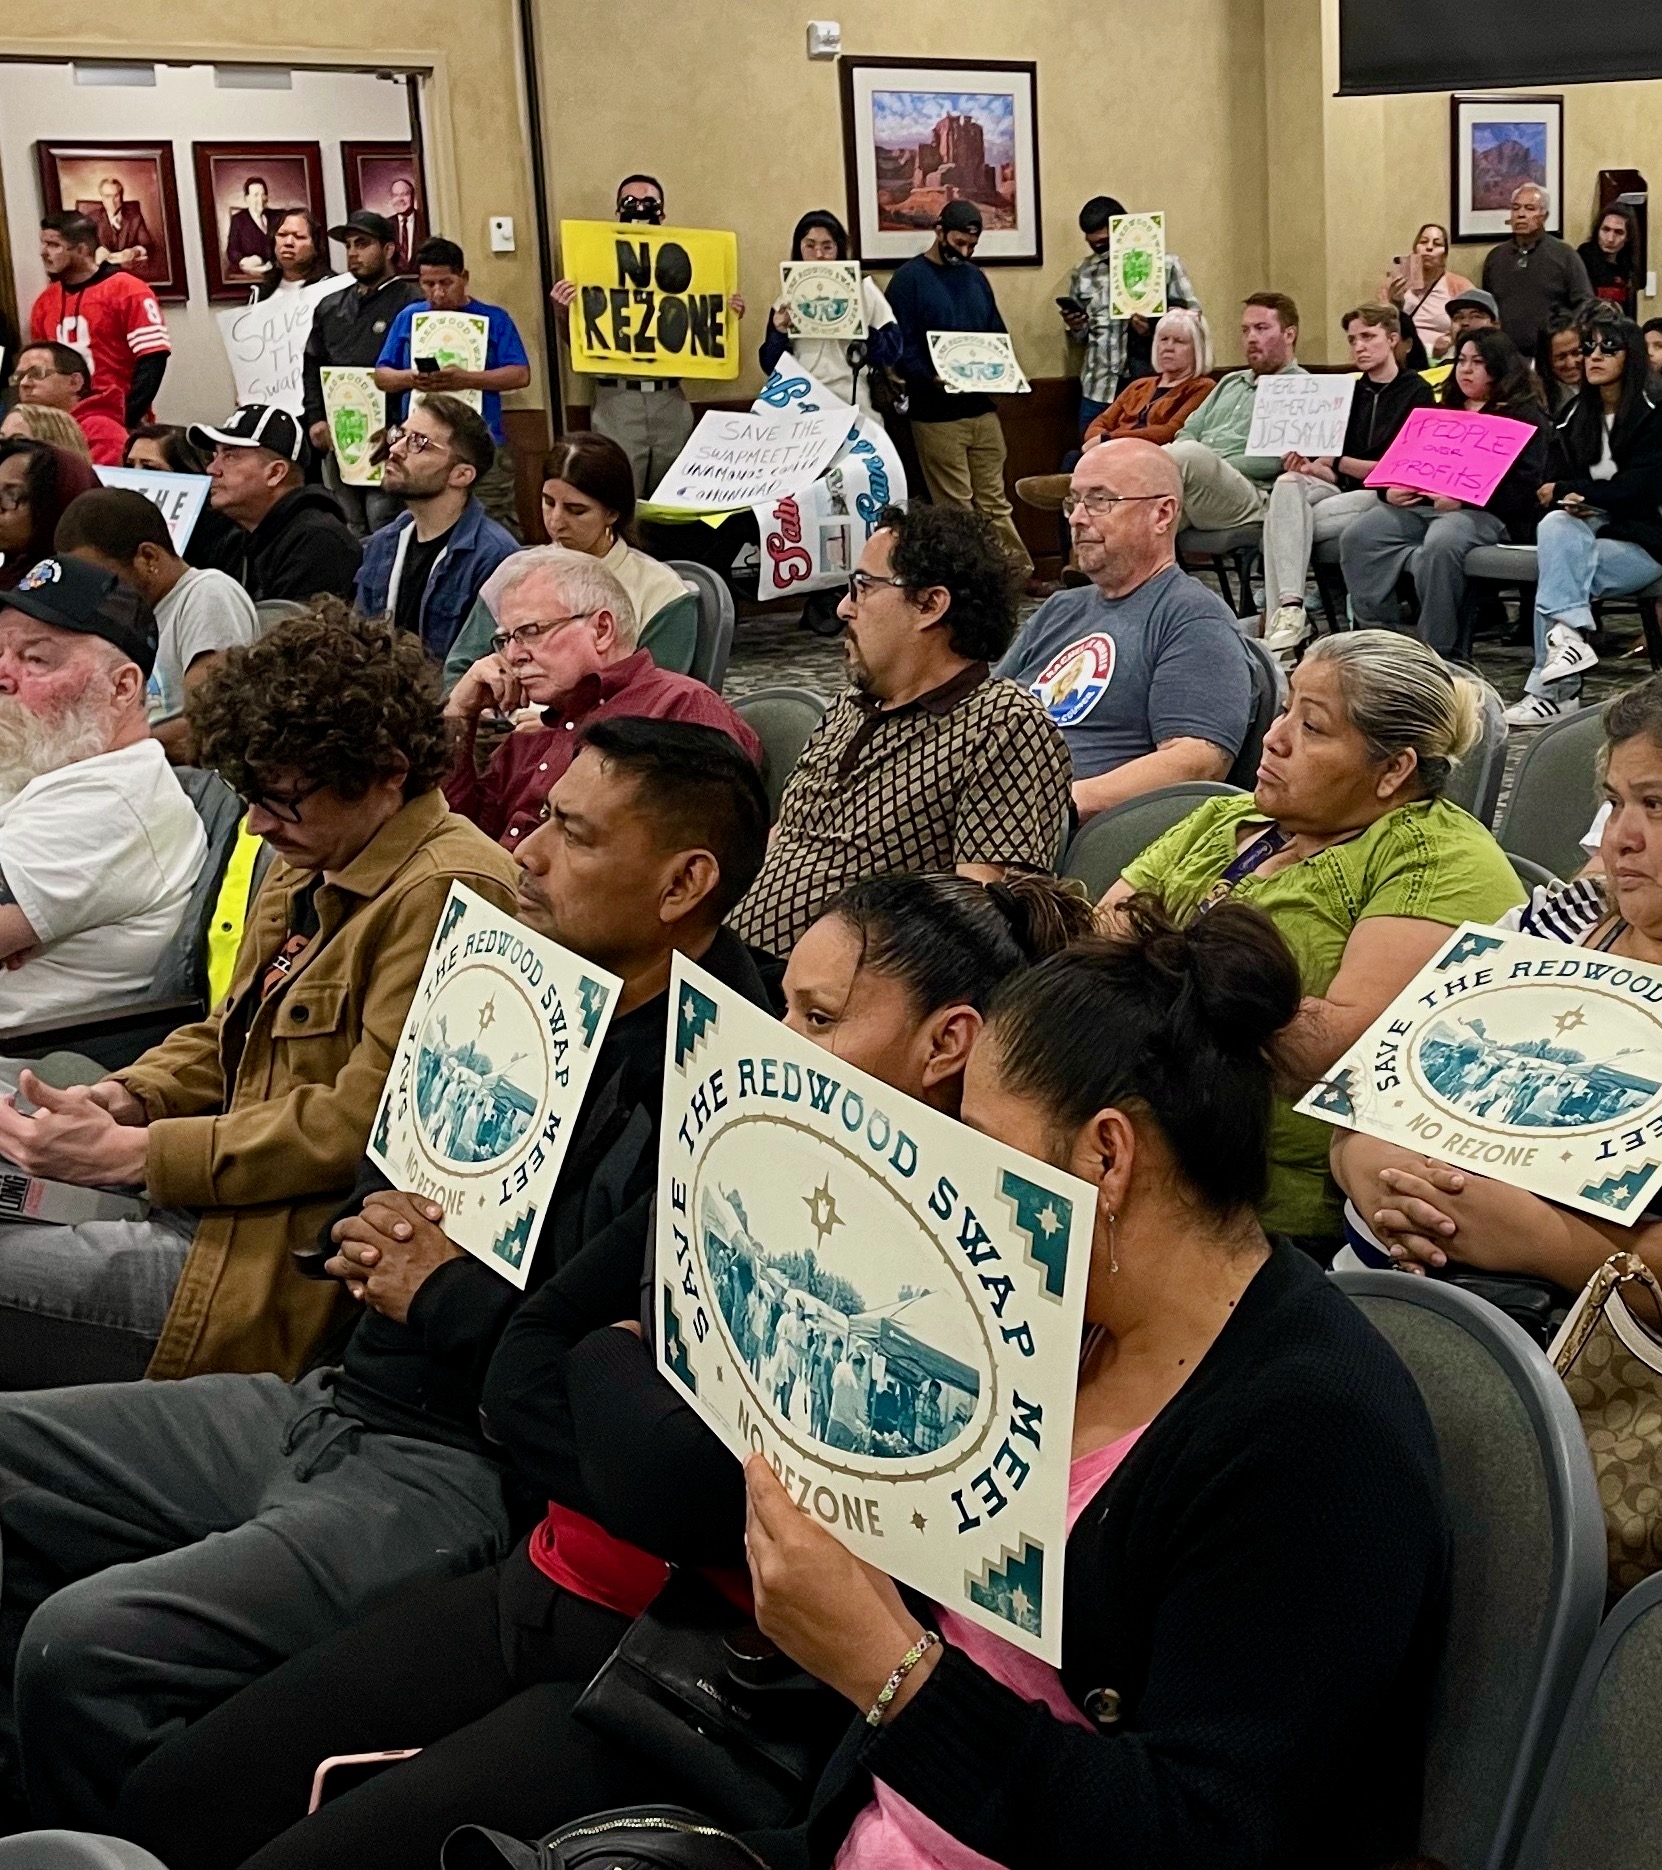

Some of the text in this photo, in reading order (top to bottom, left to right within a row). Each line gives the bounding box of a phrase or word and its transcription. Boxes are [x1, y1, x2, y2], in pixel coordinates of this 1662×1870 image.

[615, 240, 693, 295] NO
[232, 304, 310, 363] Save
[581, 286, 726, 360] REZONE
[269, 340, 304, 372] Th
[719, 418, 826, 442] SAVE THE
[766, 493, 813, 589] Sav
[1376, 1018, 1415, 1093] SAVE
[1418, 966, 1493, 1010] THE
[396, 929, 570, 1207] SAVE THE REDWOOD SWAP MEET
[404, 1145, 420, 1185] NO
[1404, 1111, 1540, 1168] NO REZONE
[671, 1056, 1044, 1535] SAVE THE REDWOOD SWAP MEET
[737, 1397, 767, 1457] NO
